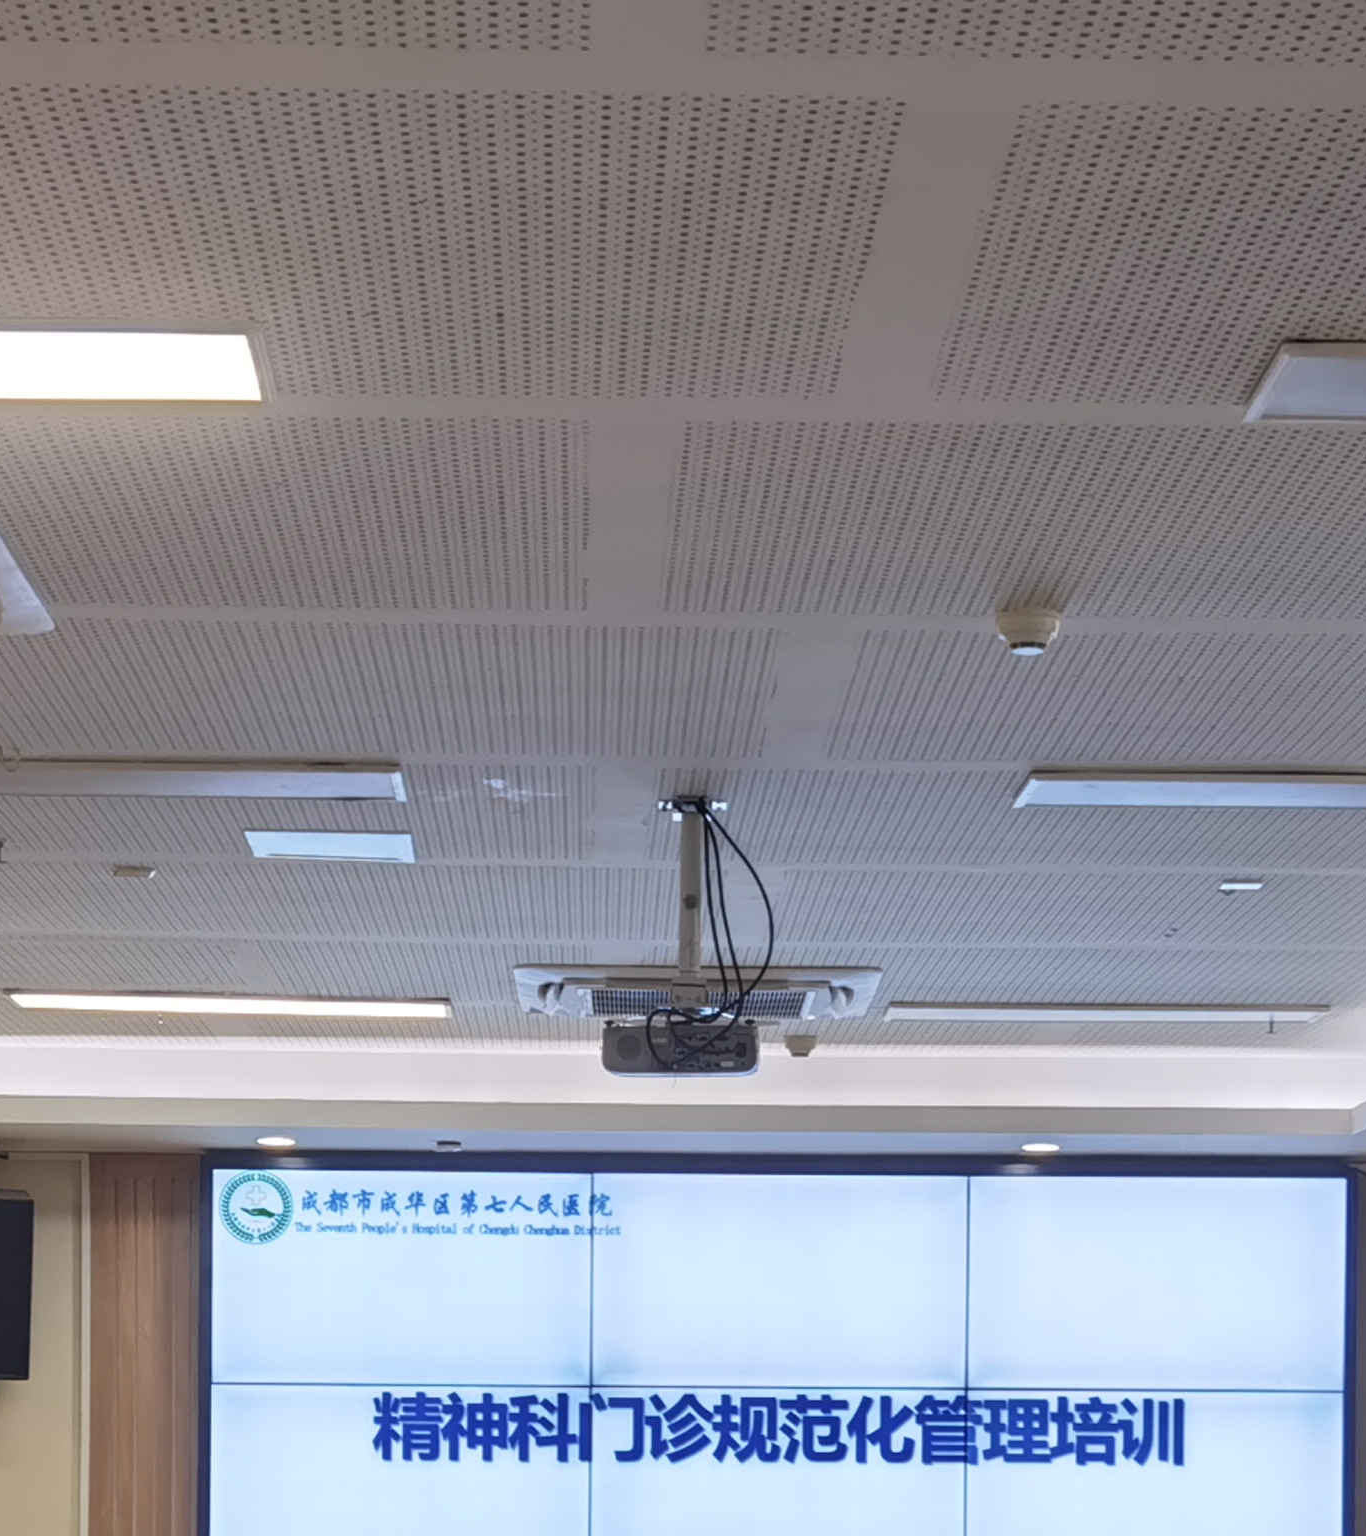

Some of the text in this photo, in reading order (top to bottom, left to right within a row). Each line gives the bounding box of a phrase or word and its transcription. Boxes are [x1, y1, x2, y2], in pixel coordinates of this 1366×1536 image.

[301, 1189, 613, 1218] 成都市成华区第七人民医院
[295, 1222, 312, 1233] The
[317, 1222, 357, 1233] Seventh
[412, 1222, 457, 1235] Hospital
[463, 1223, 475, 1234] of
[479, 1223, 520, 1236] Chengdu
[574, 1224, 621, 1235] District
[372, 1391, 1185, 1466] 精神科门诊规范化管理培训
